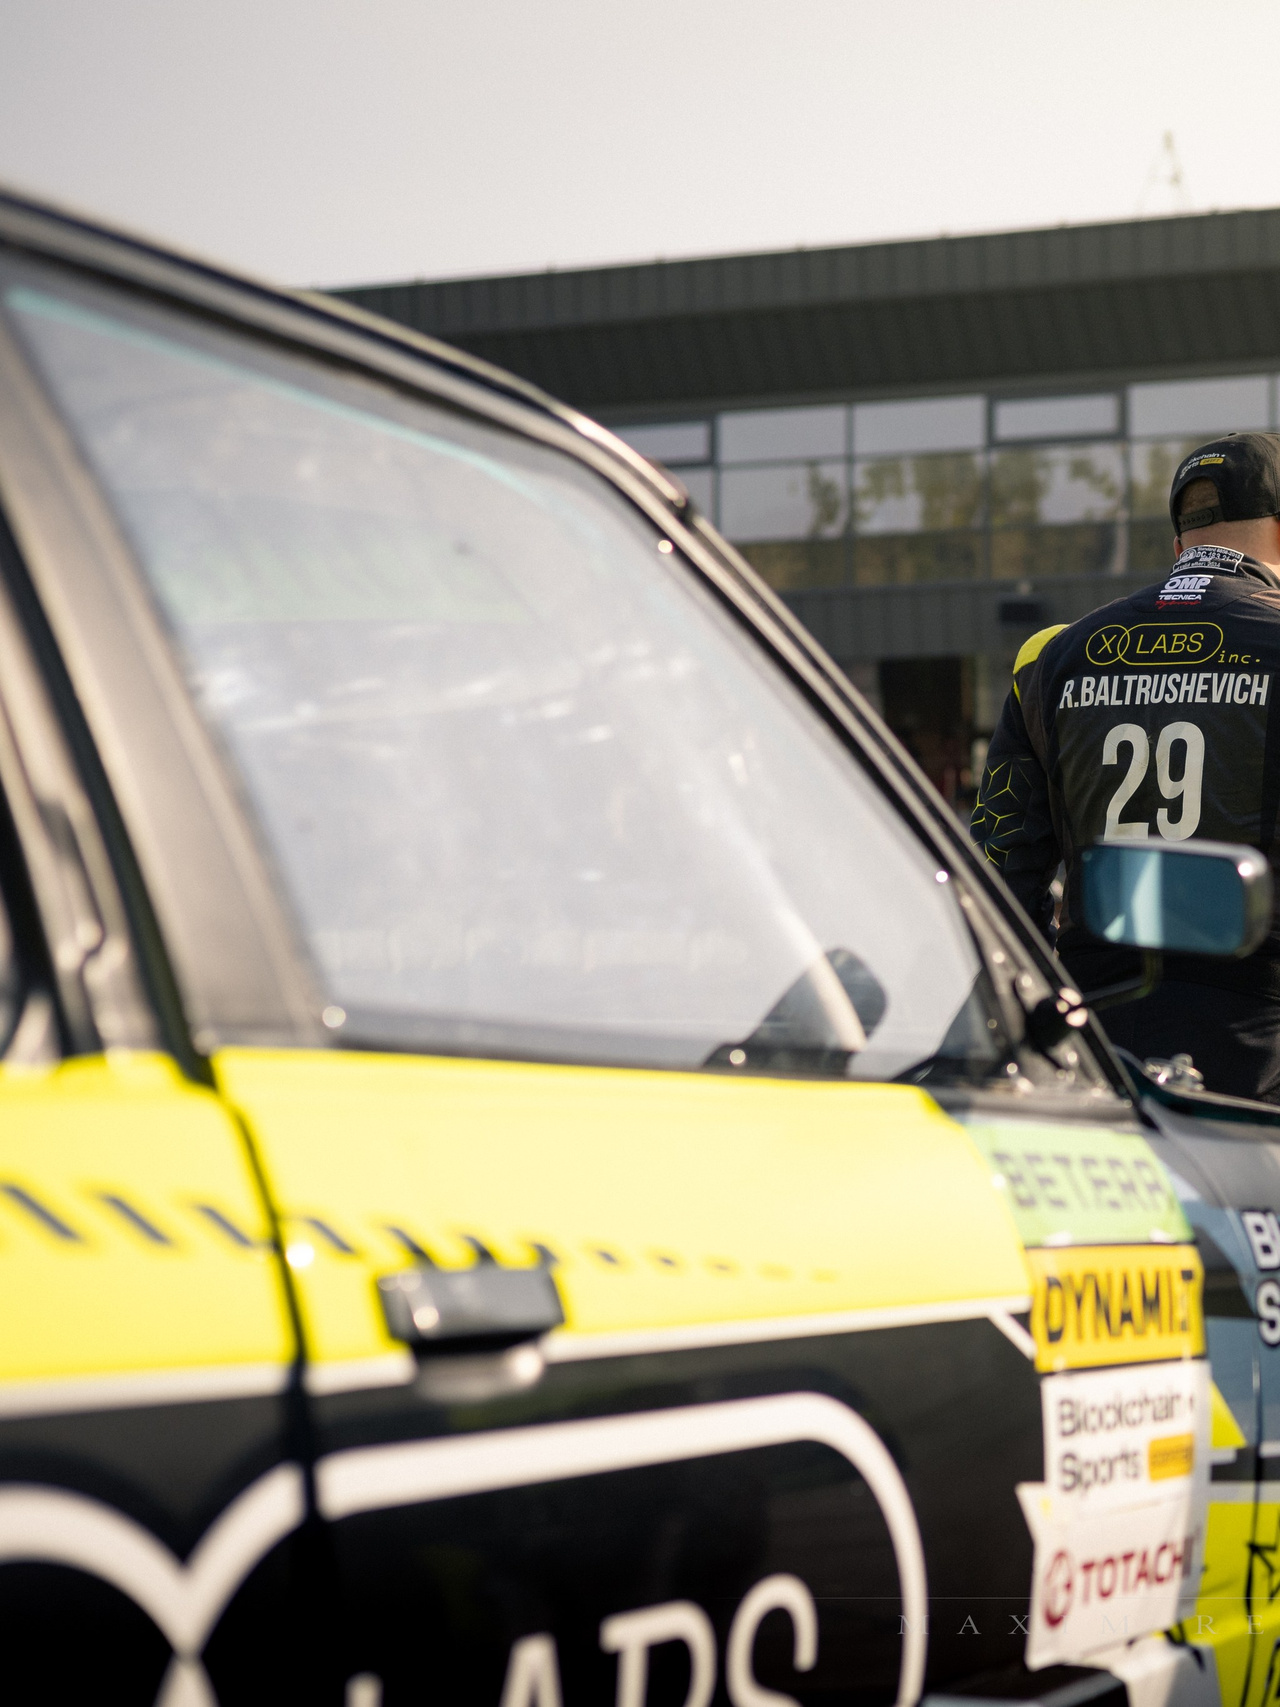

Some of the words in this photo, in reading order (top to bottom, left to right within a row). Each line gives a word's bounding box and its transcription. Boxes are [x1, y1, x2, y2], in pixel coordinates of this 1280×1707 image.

[1164, 578, 1211, 590] OMP
[1097, 634, 1117, 654] X
[1136, 632, 1205, 654] LABS
[1218, 650, 1261, 664] inc.
[1059, 672, 1270, 709] R.BALTRUSHEVICH
[1102, 721, 1206, 842] 29
[1061, 1448, 1141, 1497] Sports
